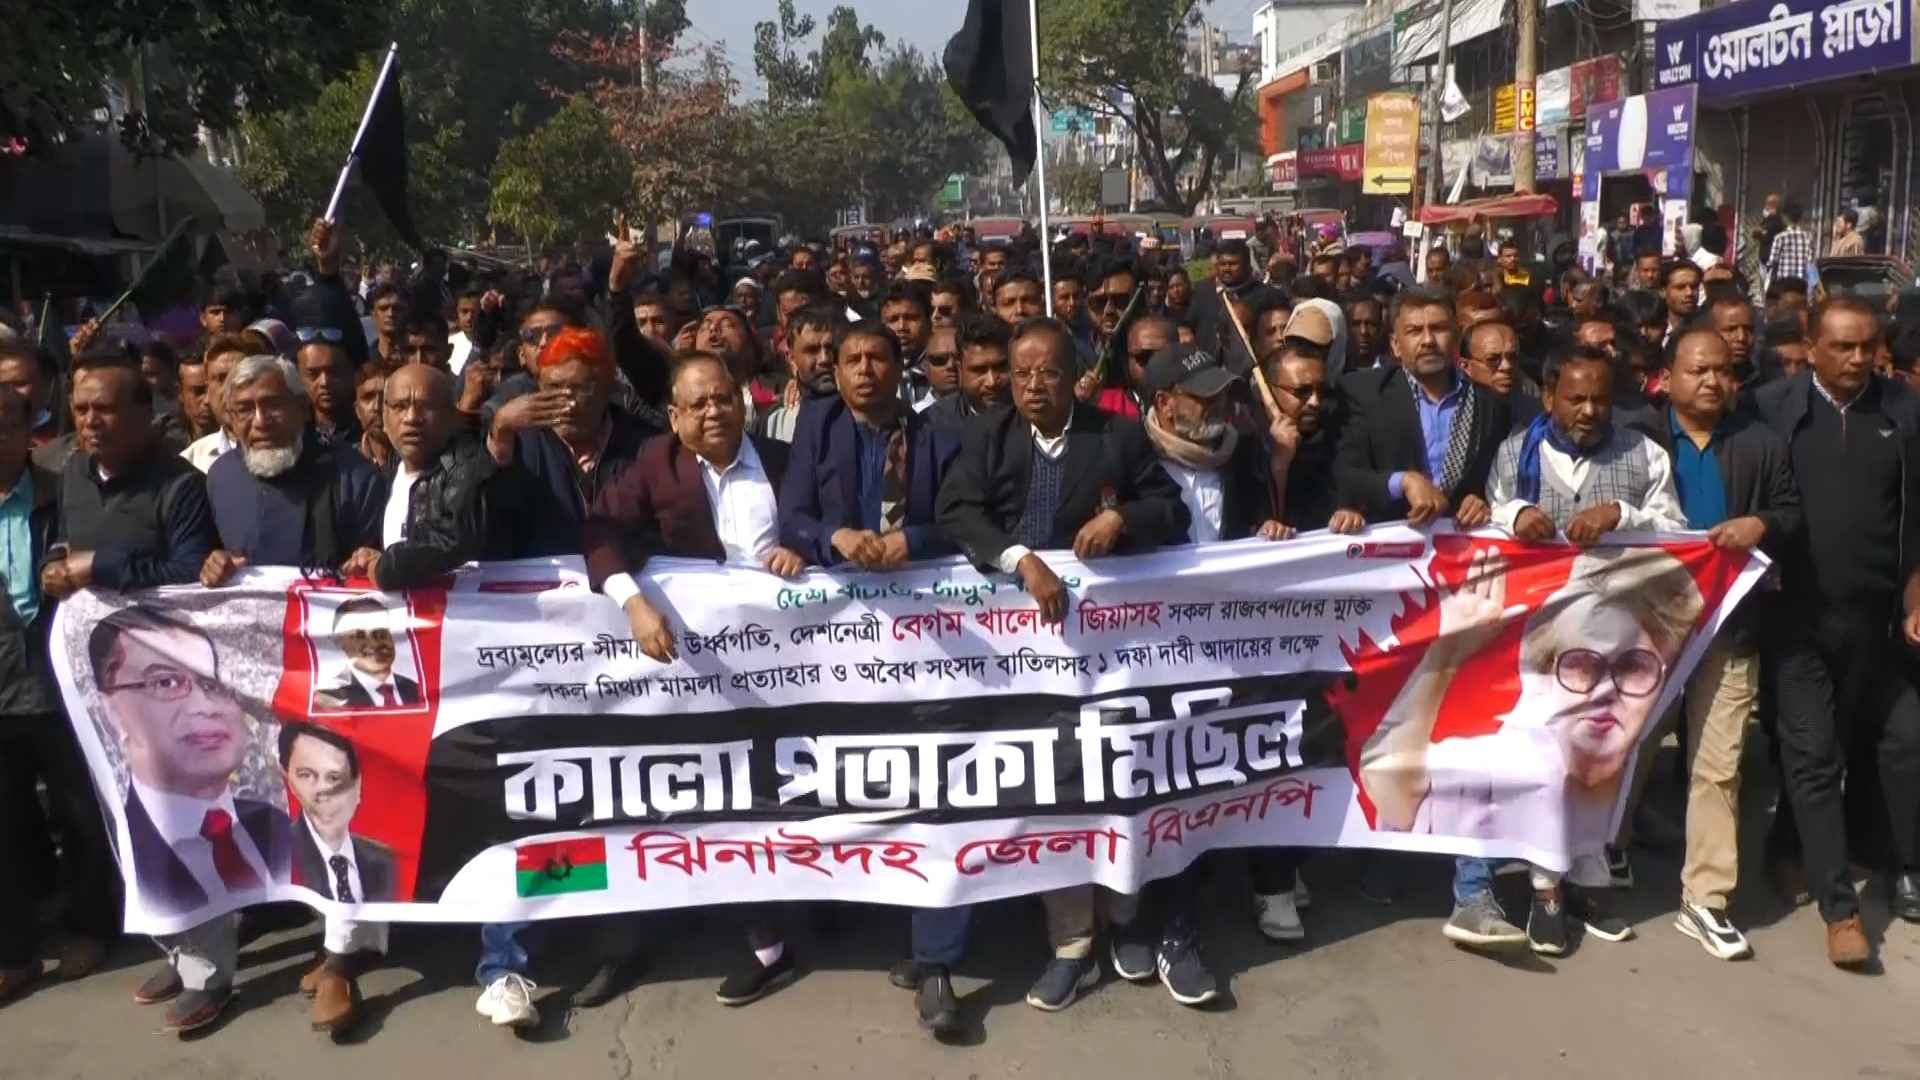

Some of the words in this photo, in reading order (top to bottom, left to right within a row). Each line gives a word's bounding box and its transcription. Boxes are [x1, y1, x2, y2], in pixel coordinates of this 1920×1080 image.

[1659, 63, 1692, 84] WALTON
[1704, 3, 1814, 80] ওয়ালটন
[1820, 0, 1901, 59] প্লাজা
[476, 641, 586, 672] দ্রব্যমূল্যের
[790, 613, 882, 645] দেশনেত্রী
[892, 608, 965, 641] বেগম
[1077, 599, 1163, 635] জিয়াসহ
[1168, 602, 1215, 624] সকল
[596, 673, 653, 698] মিথ্যা
[656, 674, 722, 697] মামলা
[731, 663, 822, 692] প্রত্যাহার
[831, 665, 848, 682] ও
[855, 657, 918, 684] অবৈধ
[926, 655, 986, 680] সংসদ
[996, 647, 1091, 678] বাতিলসহ
[1097, 651, 1108, 674] ১
[1115, 644, 1153, 670] দফা
[1157, 635, 1195, 665] দাবী
[1200, 636, 1275, 662] আদায়ের
[496, 738, 753, 822] কালো
[775, 732, 1059, 809] পতাকা
[1074, 686, 1307, 803] মিছিল
[625, 827, 929, 882] ঝিনাইদহ
[956, 827, 1129, 876] জেলা
[1142, 778, 1323, 857] বিএনপি
